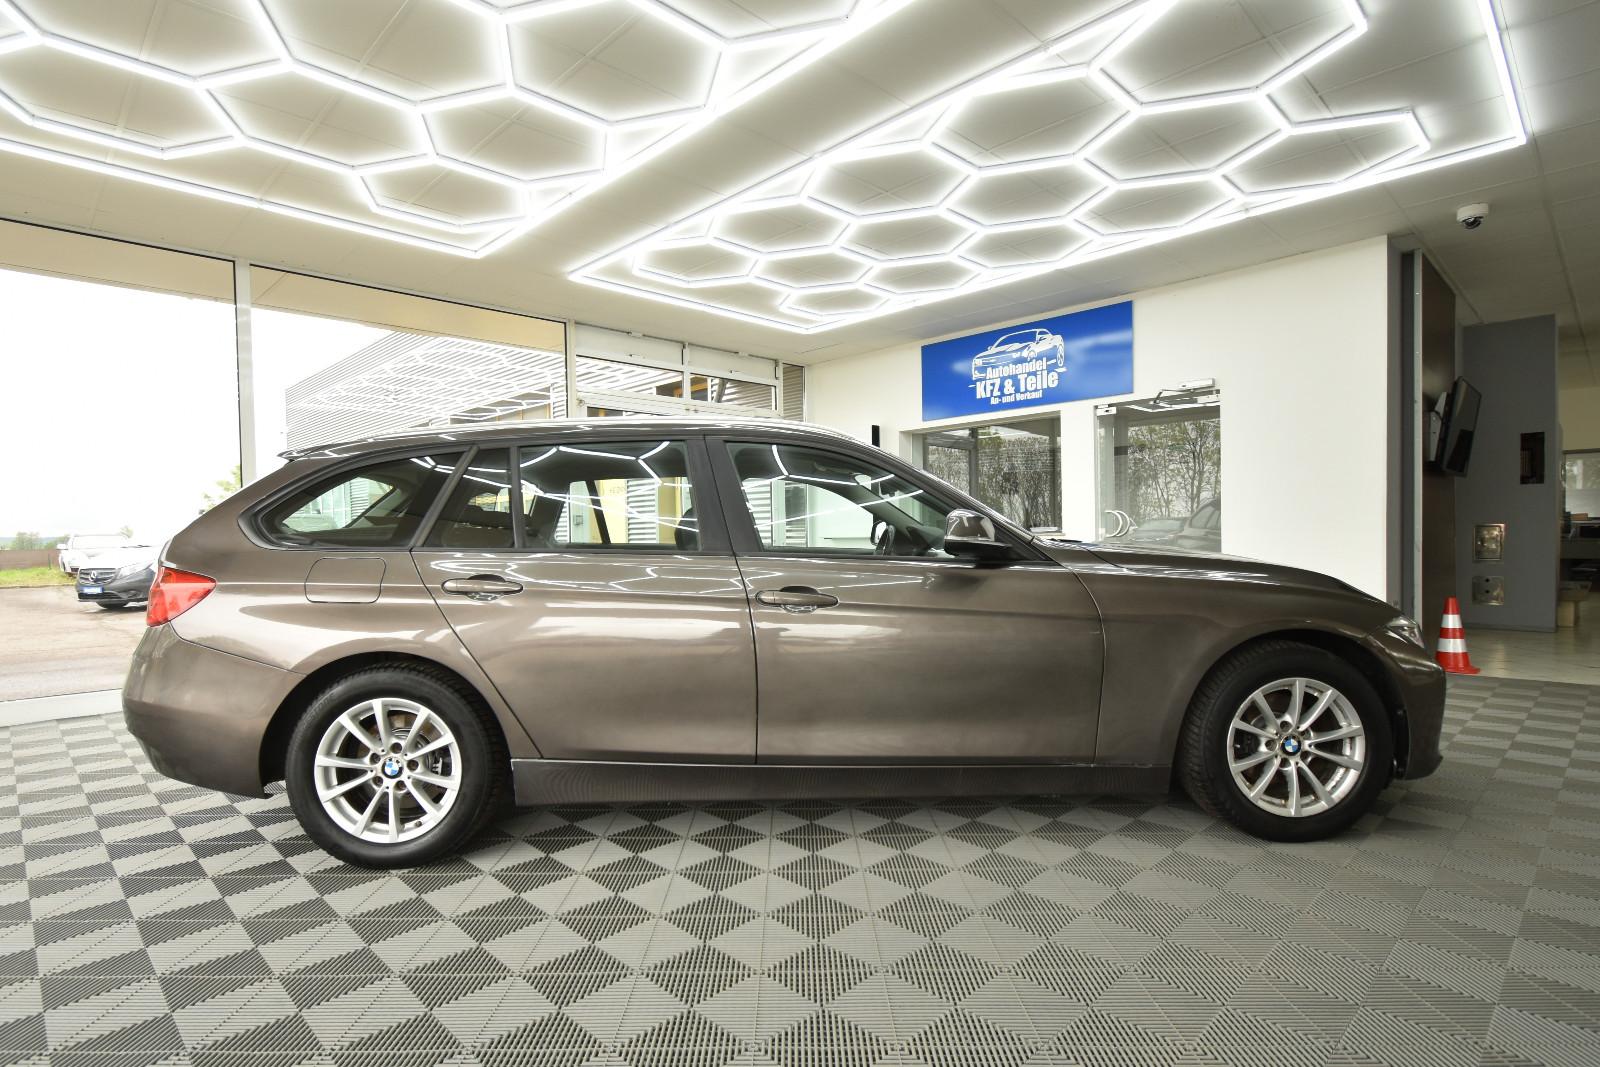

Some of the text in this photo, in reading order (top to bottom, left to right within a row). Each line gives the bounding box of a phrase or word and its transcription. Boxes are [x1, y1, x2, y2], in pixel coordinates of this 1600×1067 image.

[986, 358, 1046, 379] Autohandel
[976, 370, 1059, 398] KFZ & Teile
[1002, 395, 1015, 403] und
[1015, 390, 1043, 401] Verkauf
